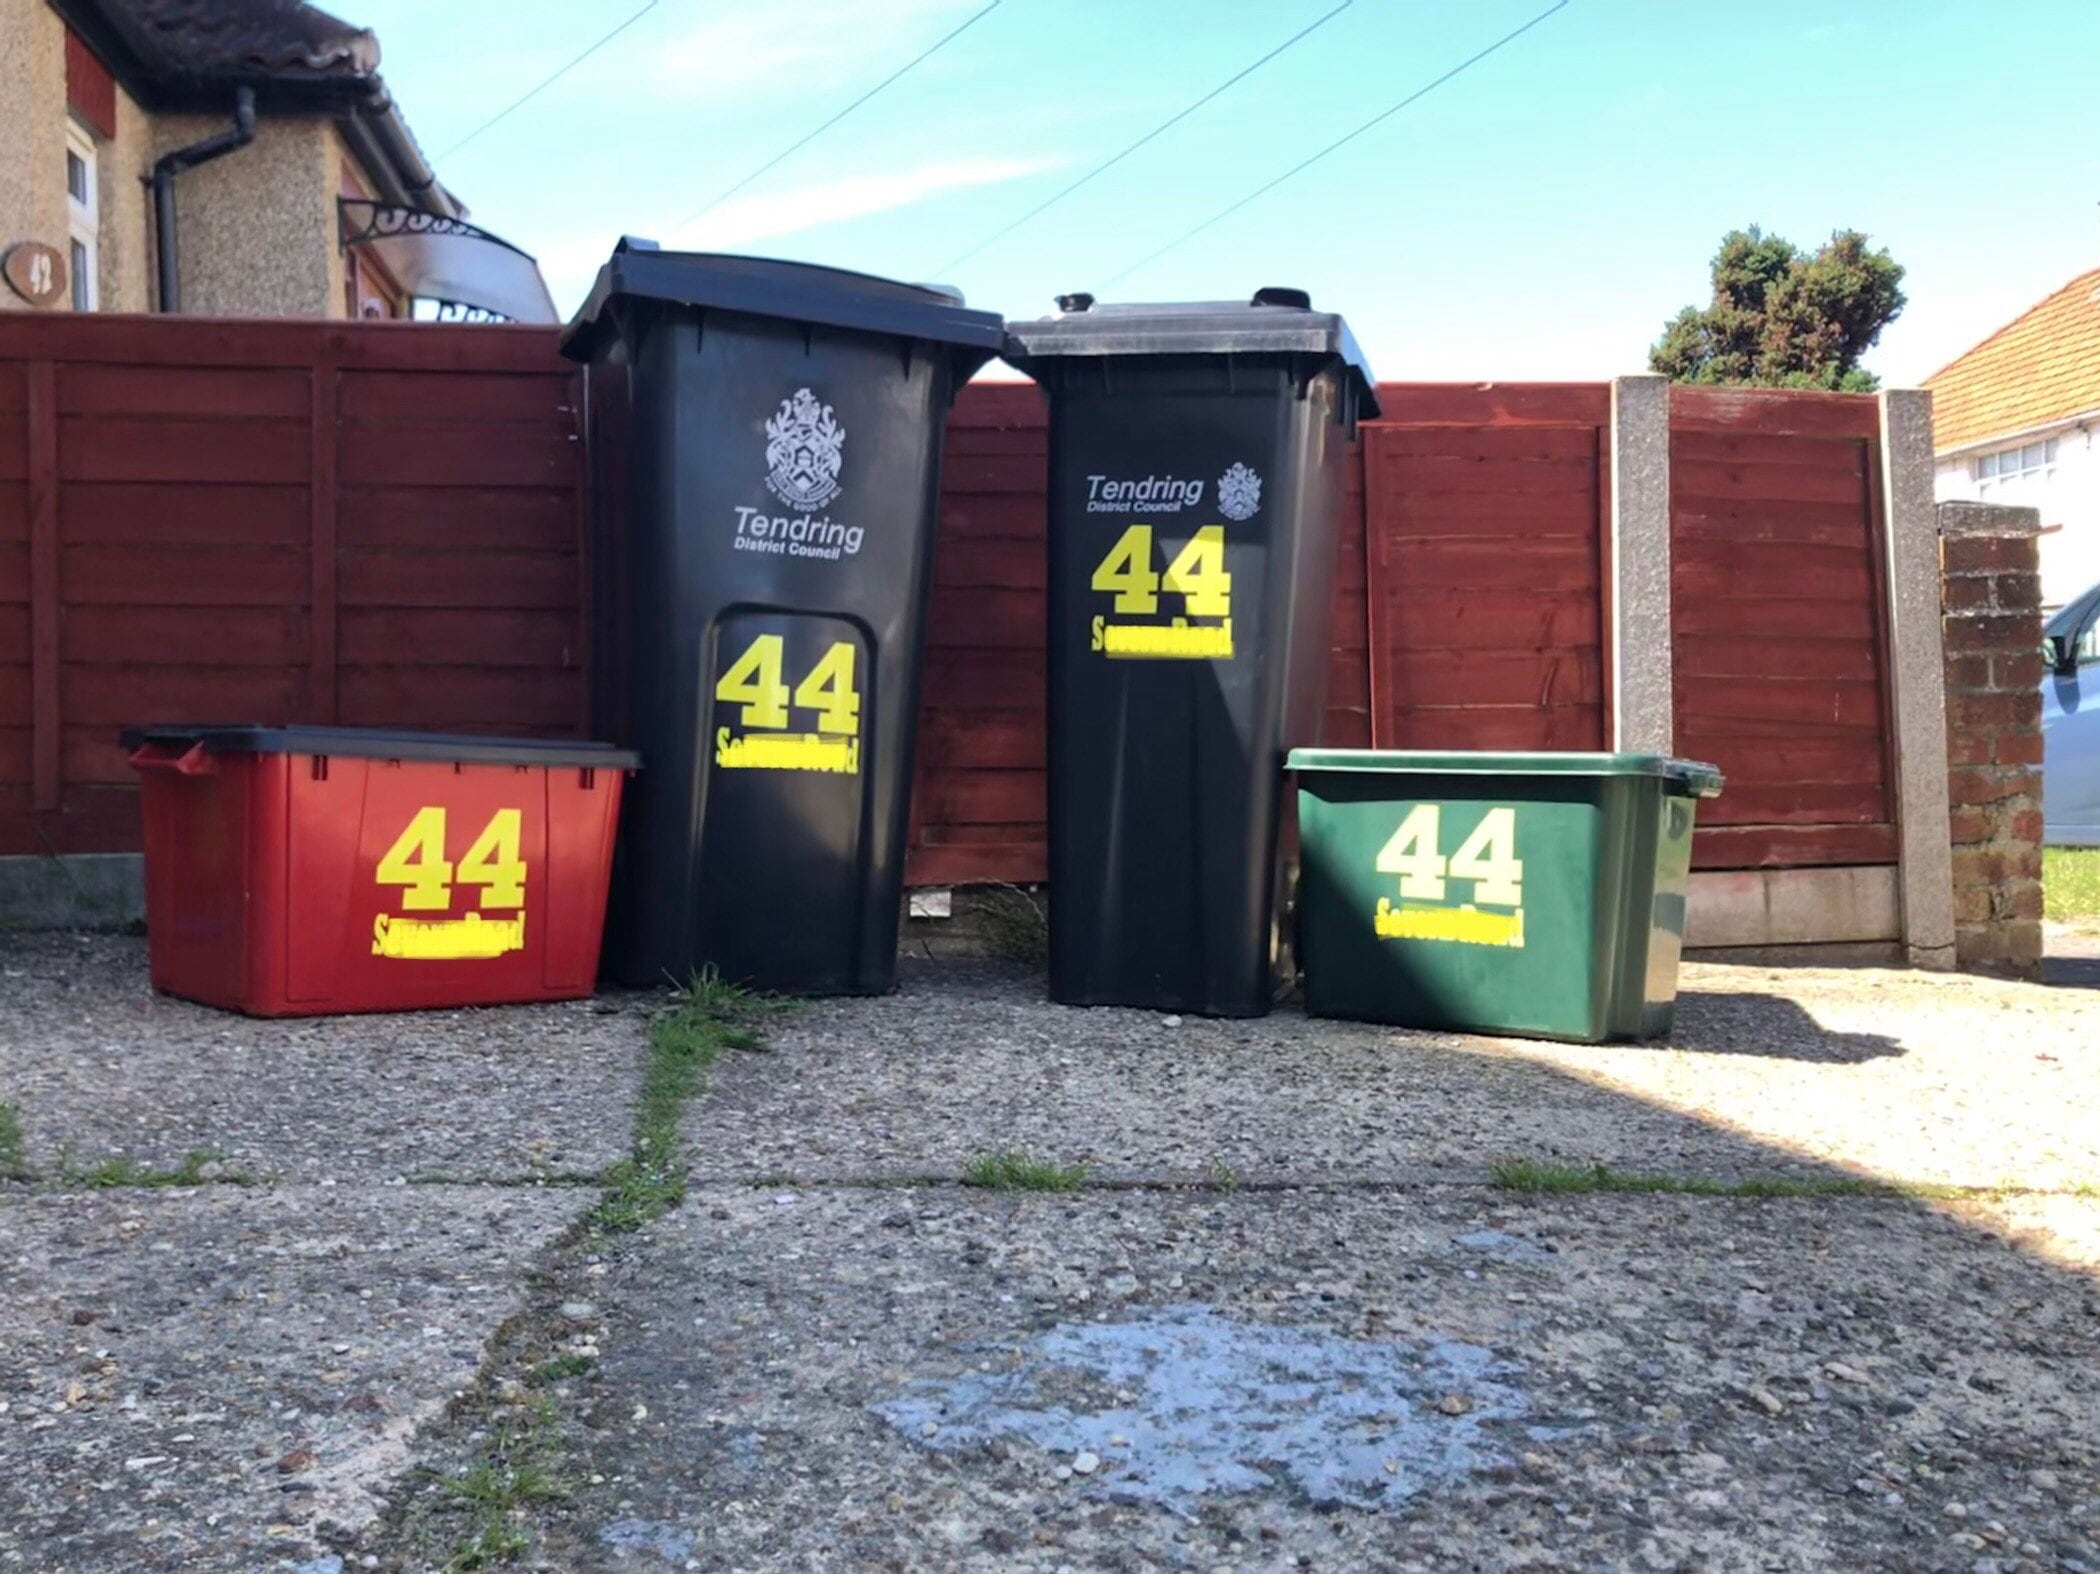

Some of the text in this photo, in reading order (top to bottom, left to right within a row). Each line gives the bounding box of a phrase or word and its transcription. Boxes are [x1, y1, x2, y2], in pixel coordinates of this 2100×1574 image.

[1086, 500, 1183, 513] District Council
[1087, 475, 1205, 506] Tendring
[734, 506, 865, 554] Tendring
[734, 536, 842, 560] District Council
[1091, 524, 1232, 616] 44
[715, 633, 860, 735] 44
[376, 807, 527, 910] 44
[1376, 804, 1524, 906] 44
